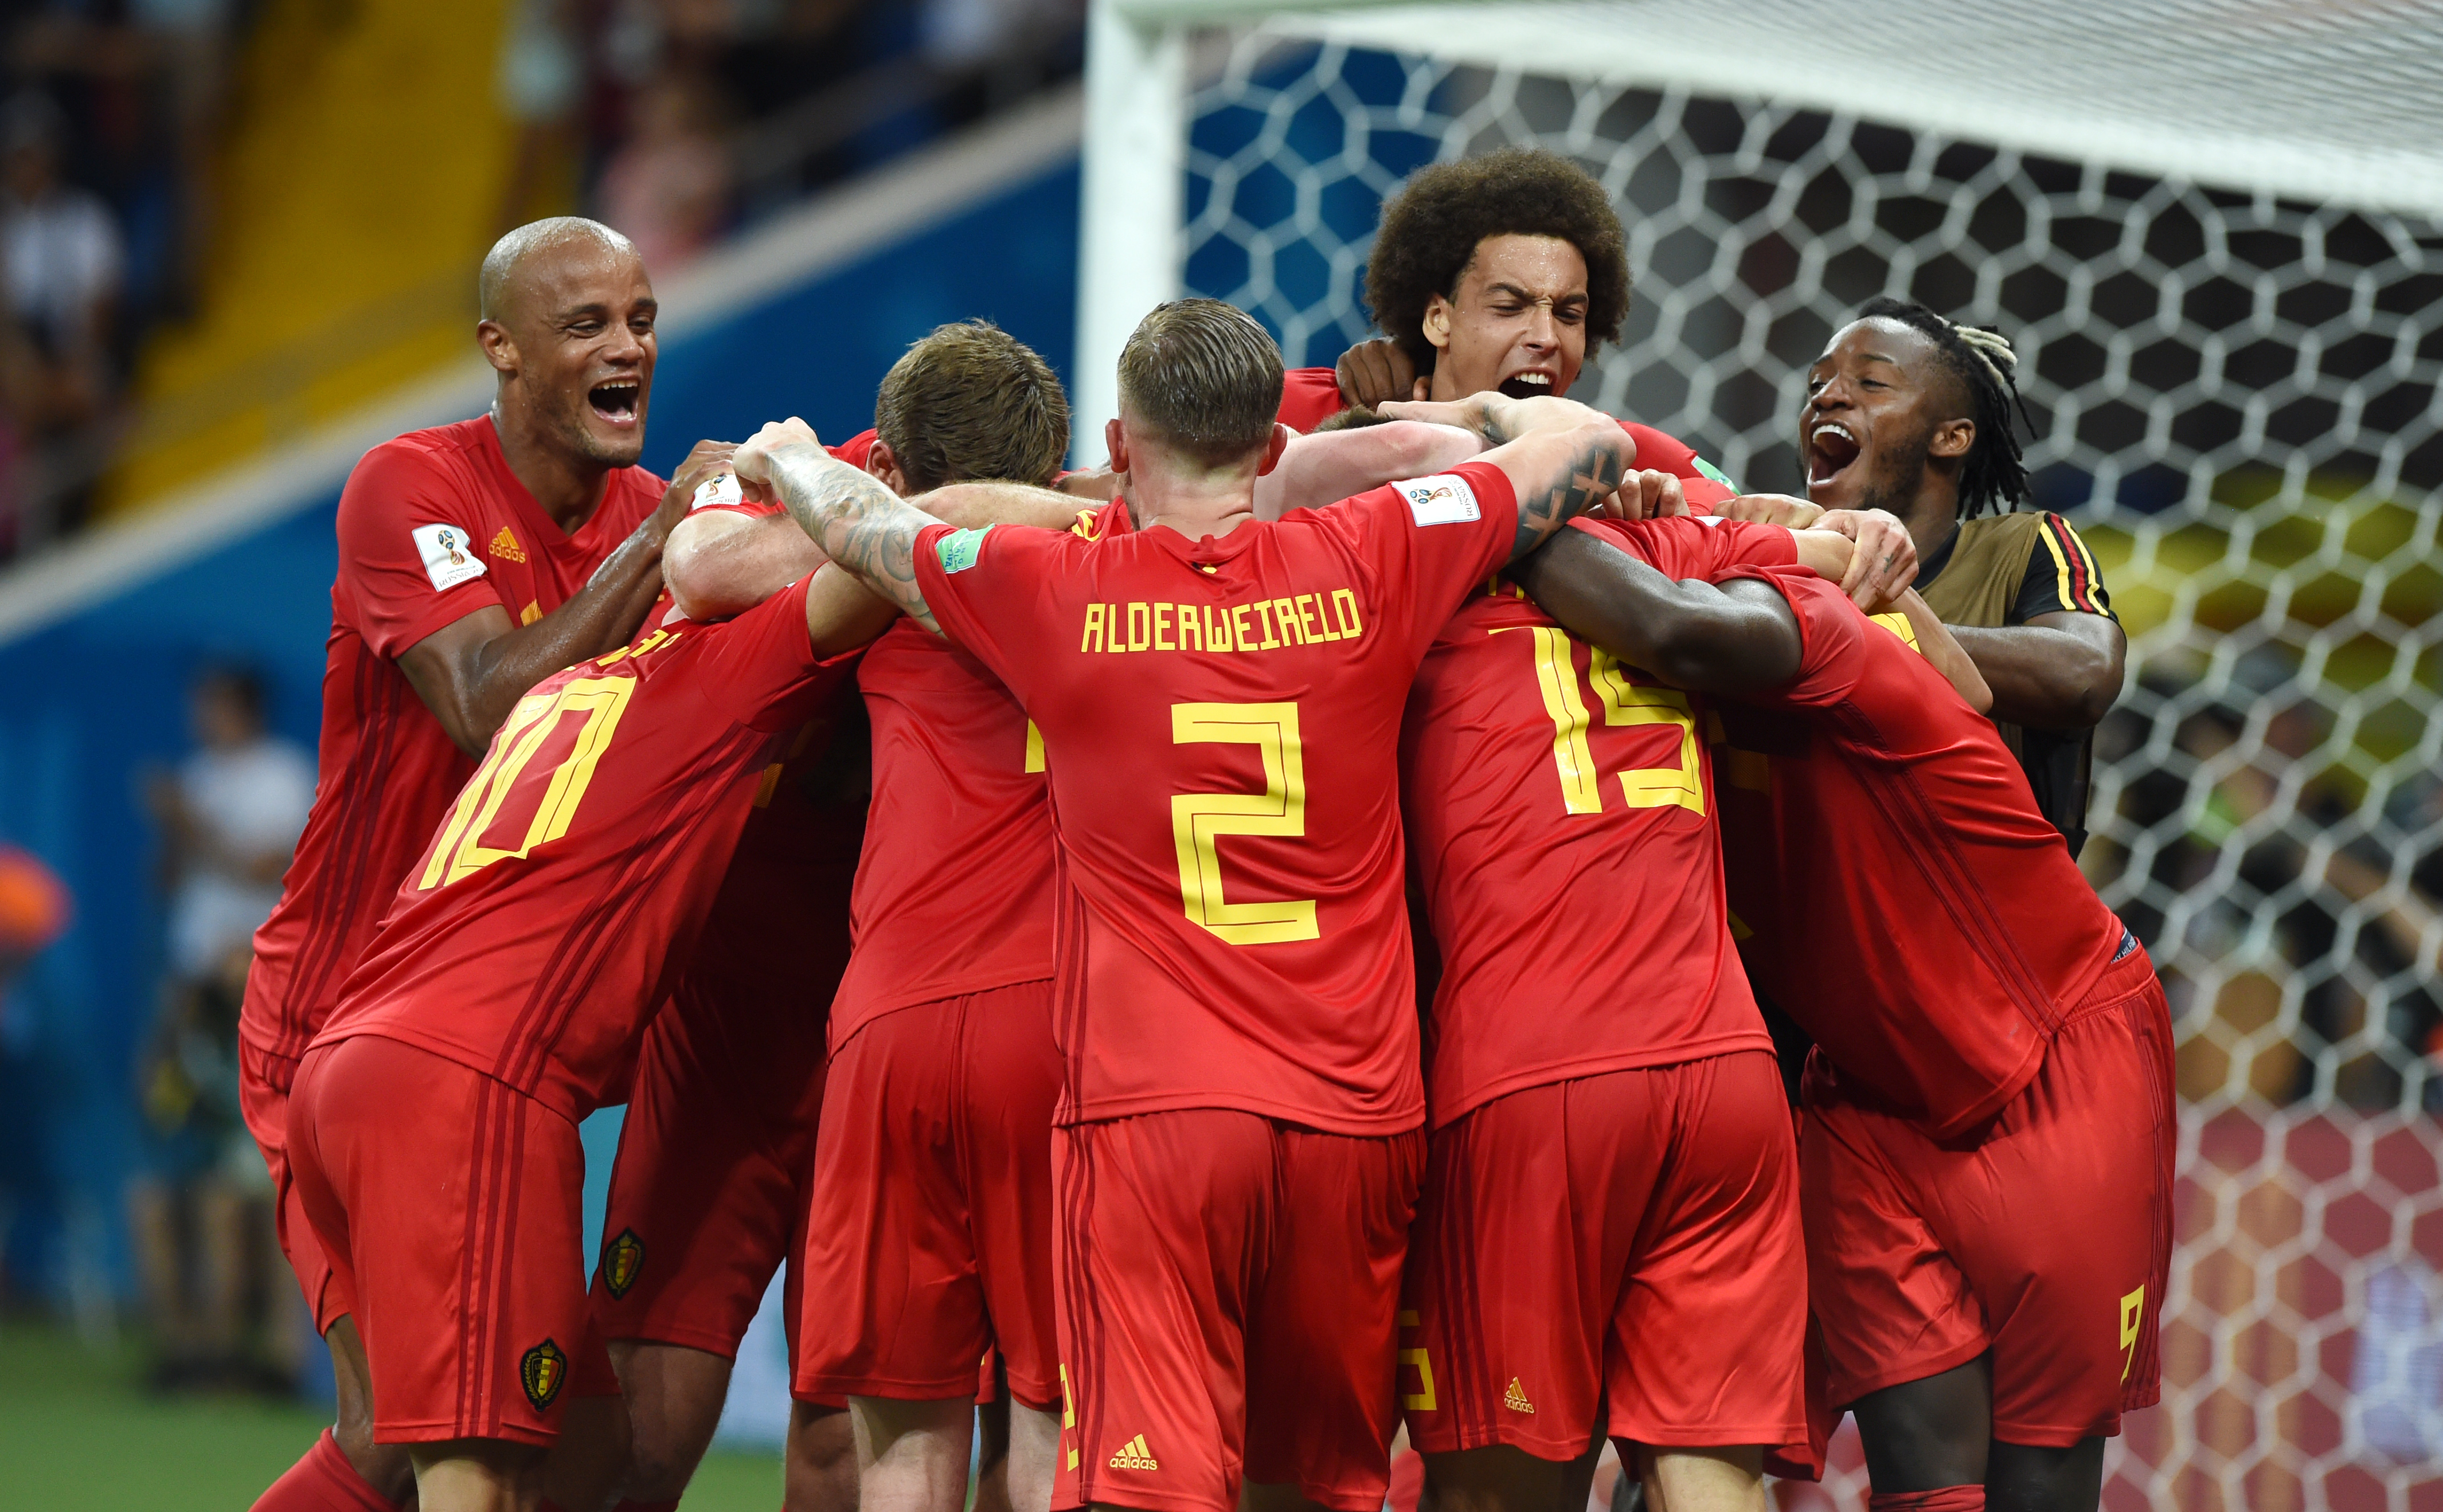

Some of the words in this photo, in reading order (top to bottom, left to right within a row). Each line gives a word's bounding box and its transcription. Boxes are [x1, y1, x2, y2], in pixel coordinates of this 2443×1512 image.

[1458, 486, 1473, 516] RUSSIA
[488, 544, 526, 564] adidas
[439, 570, 471, 587] RUSSIA
[1081, 588, 1363, 653] ALDERWEIRELD
[1488, 626, 1706, 817] 15
[417, 676, 638, 891] 10
[1171, 702, 1320, 946] 2
[2120, 1284, 2144, 1386] 9
[1504, 1397, 1535, 1414] adidas
[1109, 1455, 1158, 1471] adidas
